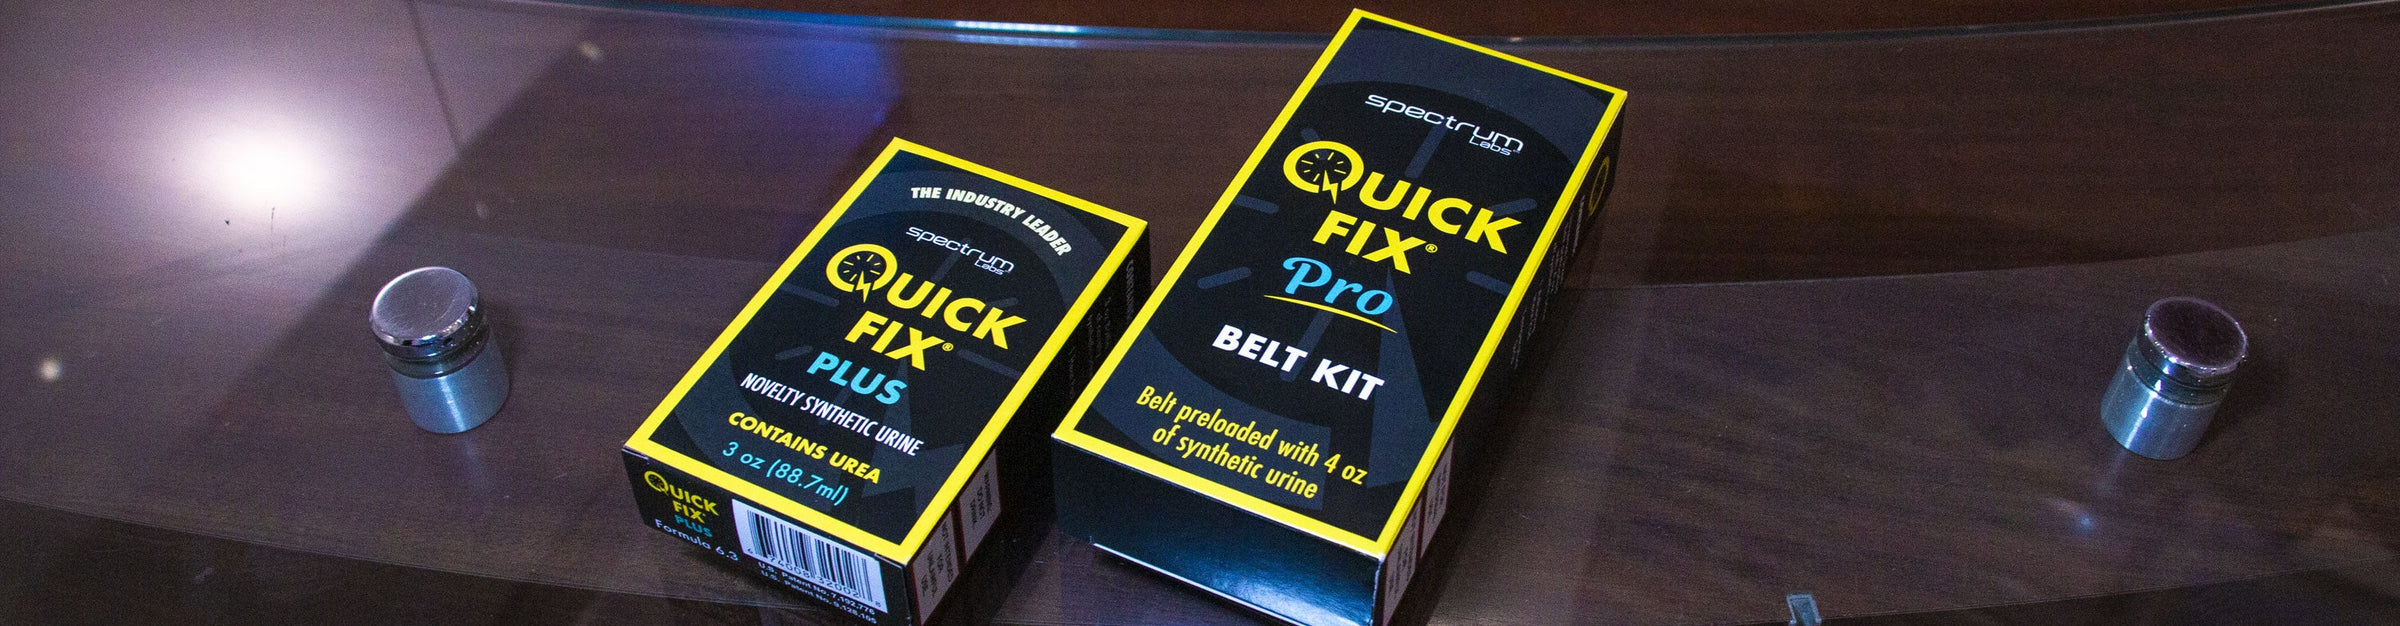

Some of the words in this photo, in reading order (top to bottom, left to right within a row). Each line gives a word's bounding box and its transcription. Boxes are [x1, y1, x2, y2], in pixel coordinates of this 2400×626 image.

[1365, 94, 1524, 152] spectrum
[1469, 136, 1513, 156] Labs
[911, 187, 942, 199] THE
[945, 188, 1026, 219] INDUSTRY
[1022, 214, 1072, 256] LEADER
[1283, 141, 1522, 254] QUICK
[905, 226, 1015, 273] spectrum
[974, 259, 1005, 276] Labs
[826, 243, 1027, 349] QUICK
[1282, 257, 1393, 315] Pro
[806, 351, 908, 405] PLUS
[1212, 324, 1308, 372] BELT
[1310, 358, 1385, 400] KIT
[740, 373, 806, 406] NOVELTY
[800, 396, 878, 437] SYNTHETIC
[874, 425, 924, 456] URINE
[1136, 385, 1177, 414] Belt
[1174, 408, 1278, 450] preloaded
[1277, 440, 1320, 467] with
[1324, 453, 1341, 474] 4
[1341, 464, 1368, 485] oz
[723, 441, 739, 457] 3
[740, 453, 766, 470] oz
[766, 458, 849, 507] (88.7ml)
[728, 411, 828, 460] CONTAINS
[829, 451, 881, 484] UREA
[1152, 424, 1181, 446] of
[1176, 436, 1263, 479] synthetic
[1265, 467, 1318, 499] urine
[644, 470, 719, 516] QUICK
[655, 518, 711, 550] Formula
[715, 546, 738, 561] 6.3
[674, 514, 713, 537] PLUS
[781, 571, 812, 589] Patent
